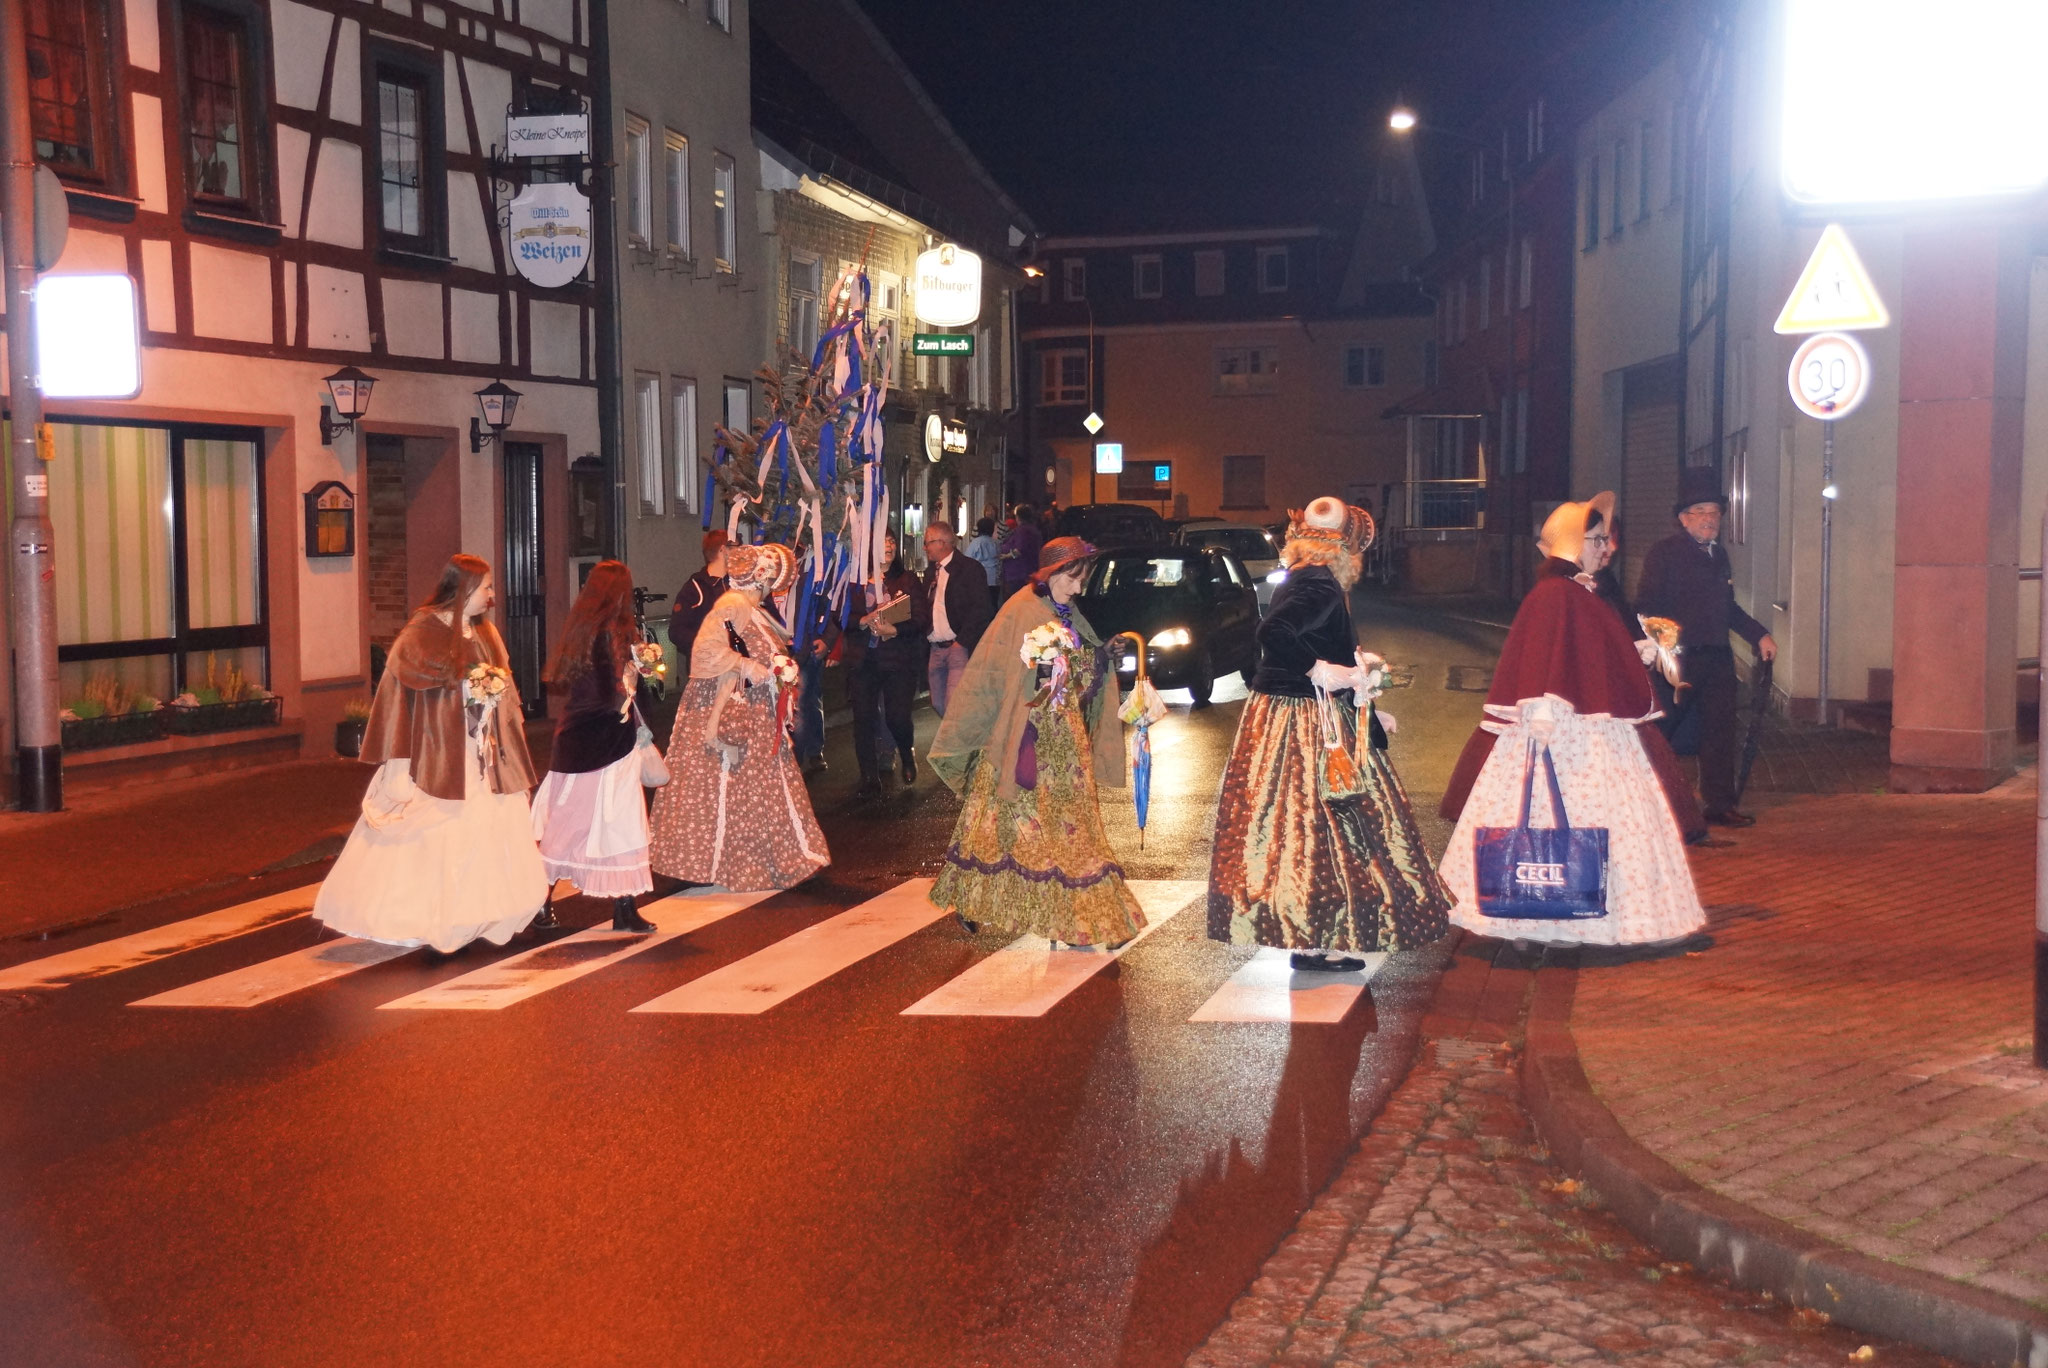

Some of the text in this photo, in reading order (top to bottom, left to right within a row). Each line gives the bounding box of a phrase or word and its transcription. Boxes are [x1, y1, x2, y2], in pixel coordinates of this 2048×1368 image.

[510, 127, 587, 142] Kleine Kneipe
[520, 242, 582, 264] Weizen
[922, 275, 974, 294] Bitburger
[917, 340, 969, 351] Zum Lasch
[1807, 358, 1846, 393] 30
[1158, 467, 1166, 480] P
[1515, 865, 1565, 881] CECIL
